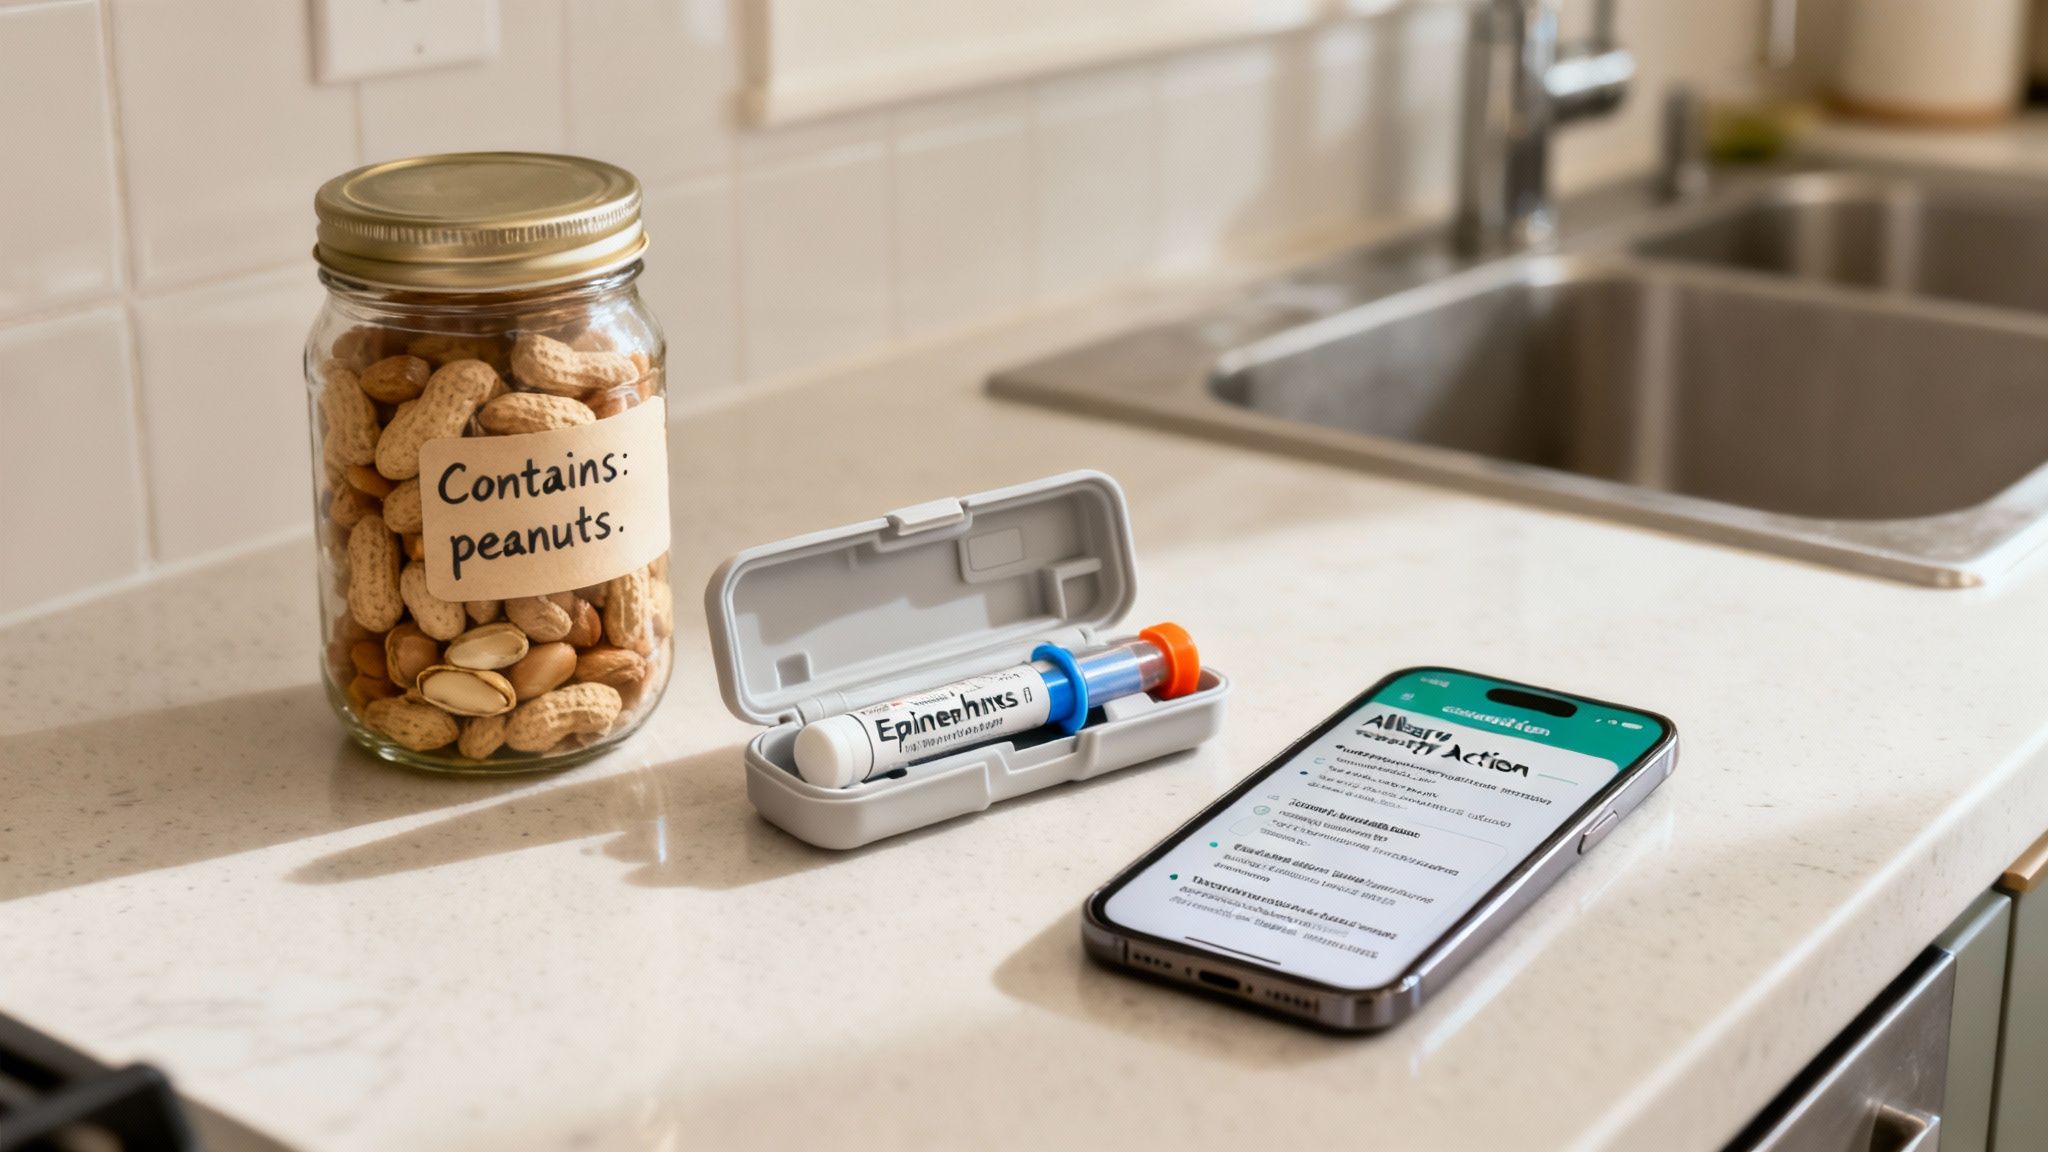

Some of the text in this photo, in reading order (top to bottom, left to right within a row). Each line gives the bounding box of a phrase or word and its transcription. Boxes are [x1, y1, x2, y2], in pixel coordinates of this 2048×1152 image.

[438, 451, 628, 505] Contains:
[450, 506, 625, 580] peanuts.
[1441, 743, 1530, 778] Action
